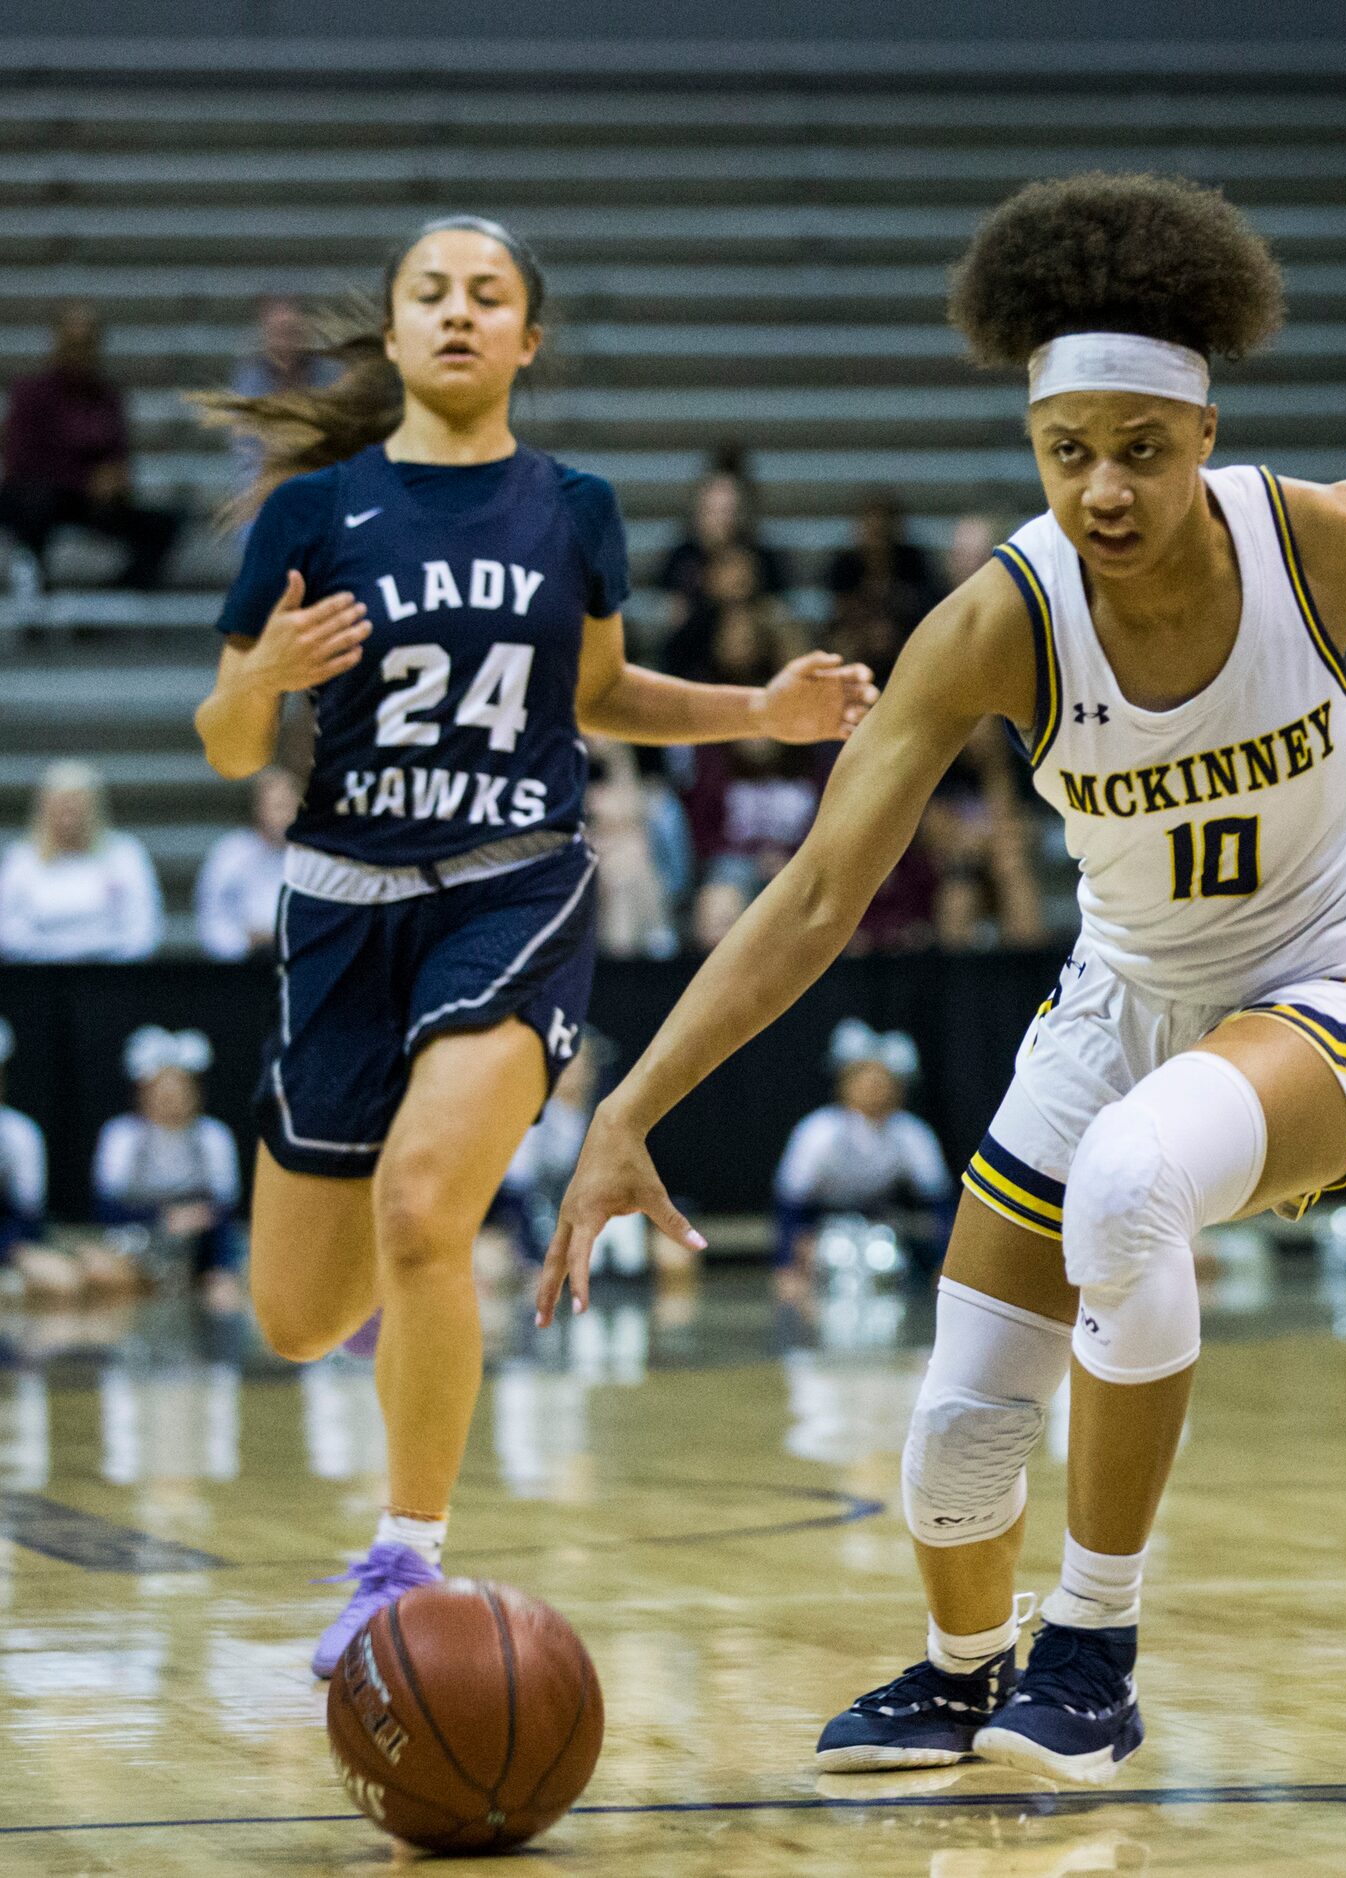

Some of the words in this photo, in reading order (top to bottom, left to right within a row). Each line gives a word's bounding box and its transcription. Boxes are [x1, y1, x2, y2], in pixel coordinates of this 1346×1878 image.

[376, 559, 545, 622] LADY
[376, 641, 536, 752] 24
[335, 767, 548, 827] HAWKS
[1059, 700, 1334, 818] MCKINNEY
[1165, 814, 1261, 902] 10
